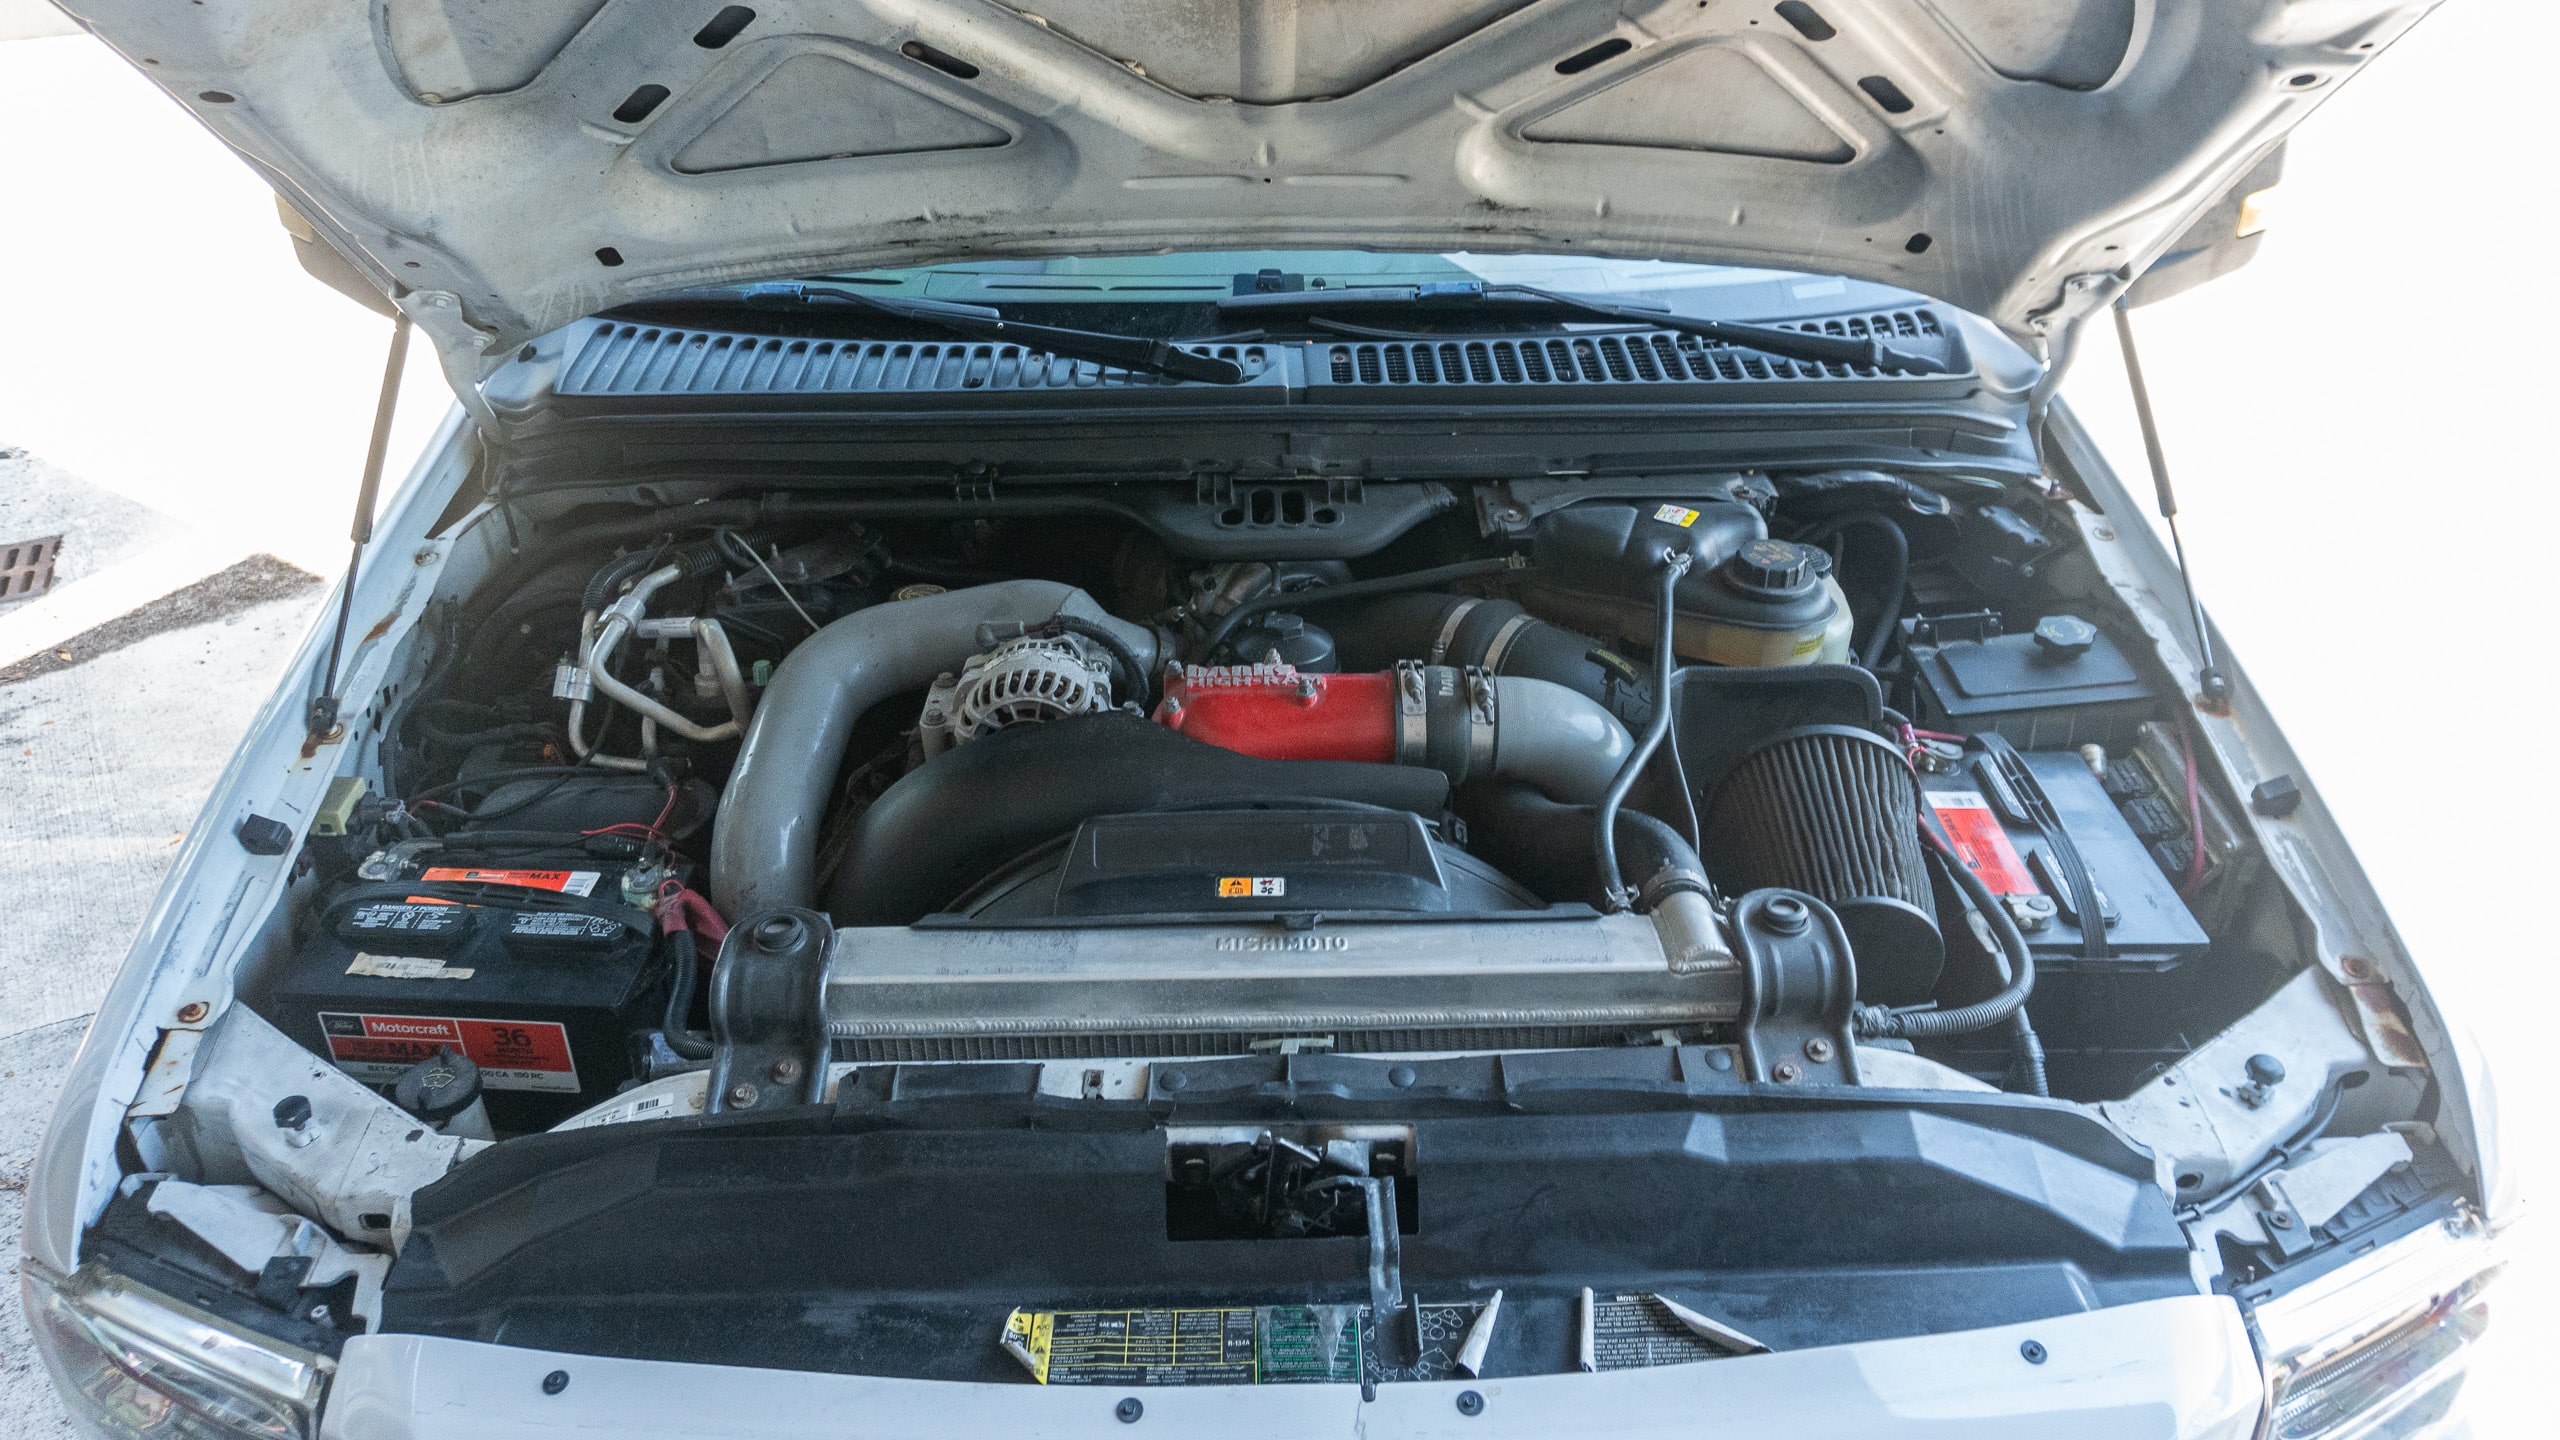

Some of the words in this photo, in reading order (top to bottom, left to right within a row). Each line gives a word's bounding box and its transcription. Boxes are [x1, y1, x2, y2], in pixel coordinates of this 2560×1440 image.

[1187, 675, 1322, 687] HIGH-RAM
[529, 872, 562, 880] MAX
[1215, 936, 1349, 951] MISHIMOTO
[371, 1021, 450, 1036] Motorcraft
[492, 1026, 532, 1047] 36
